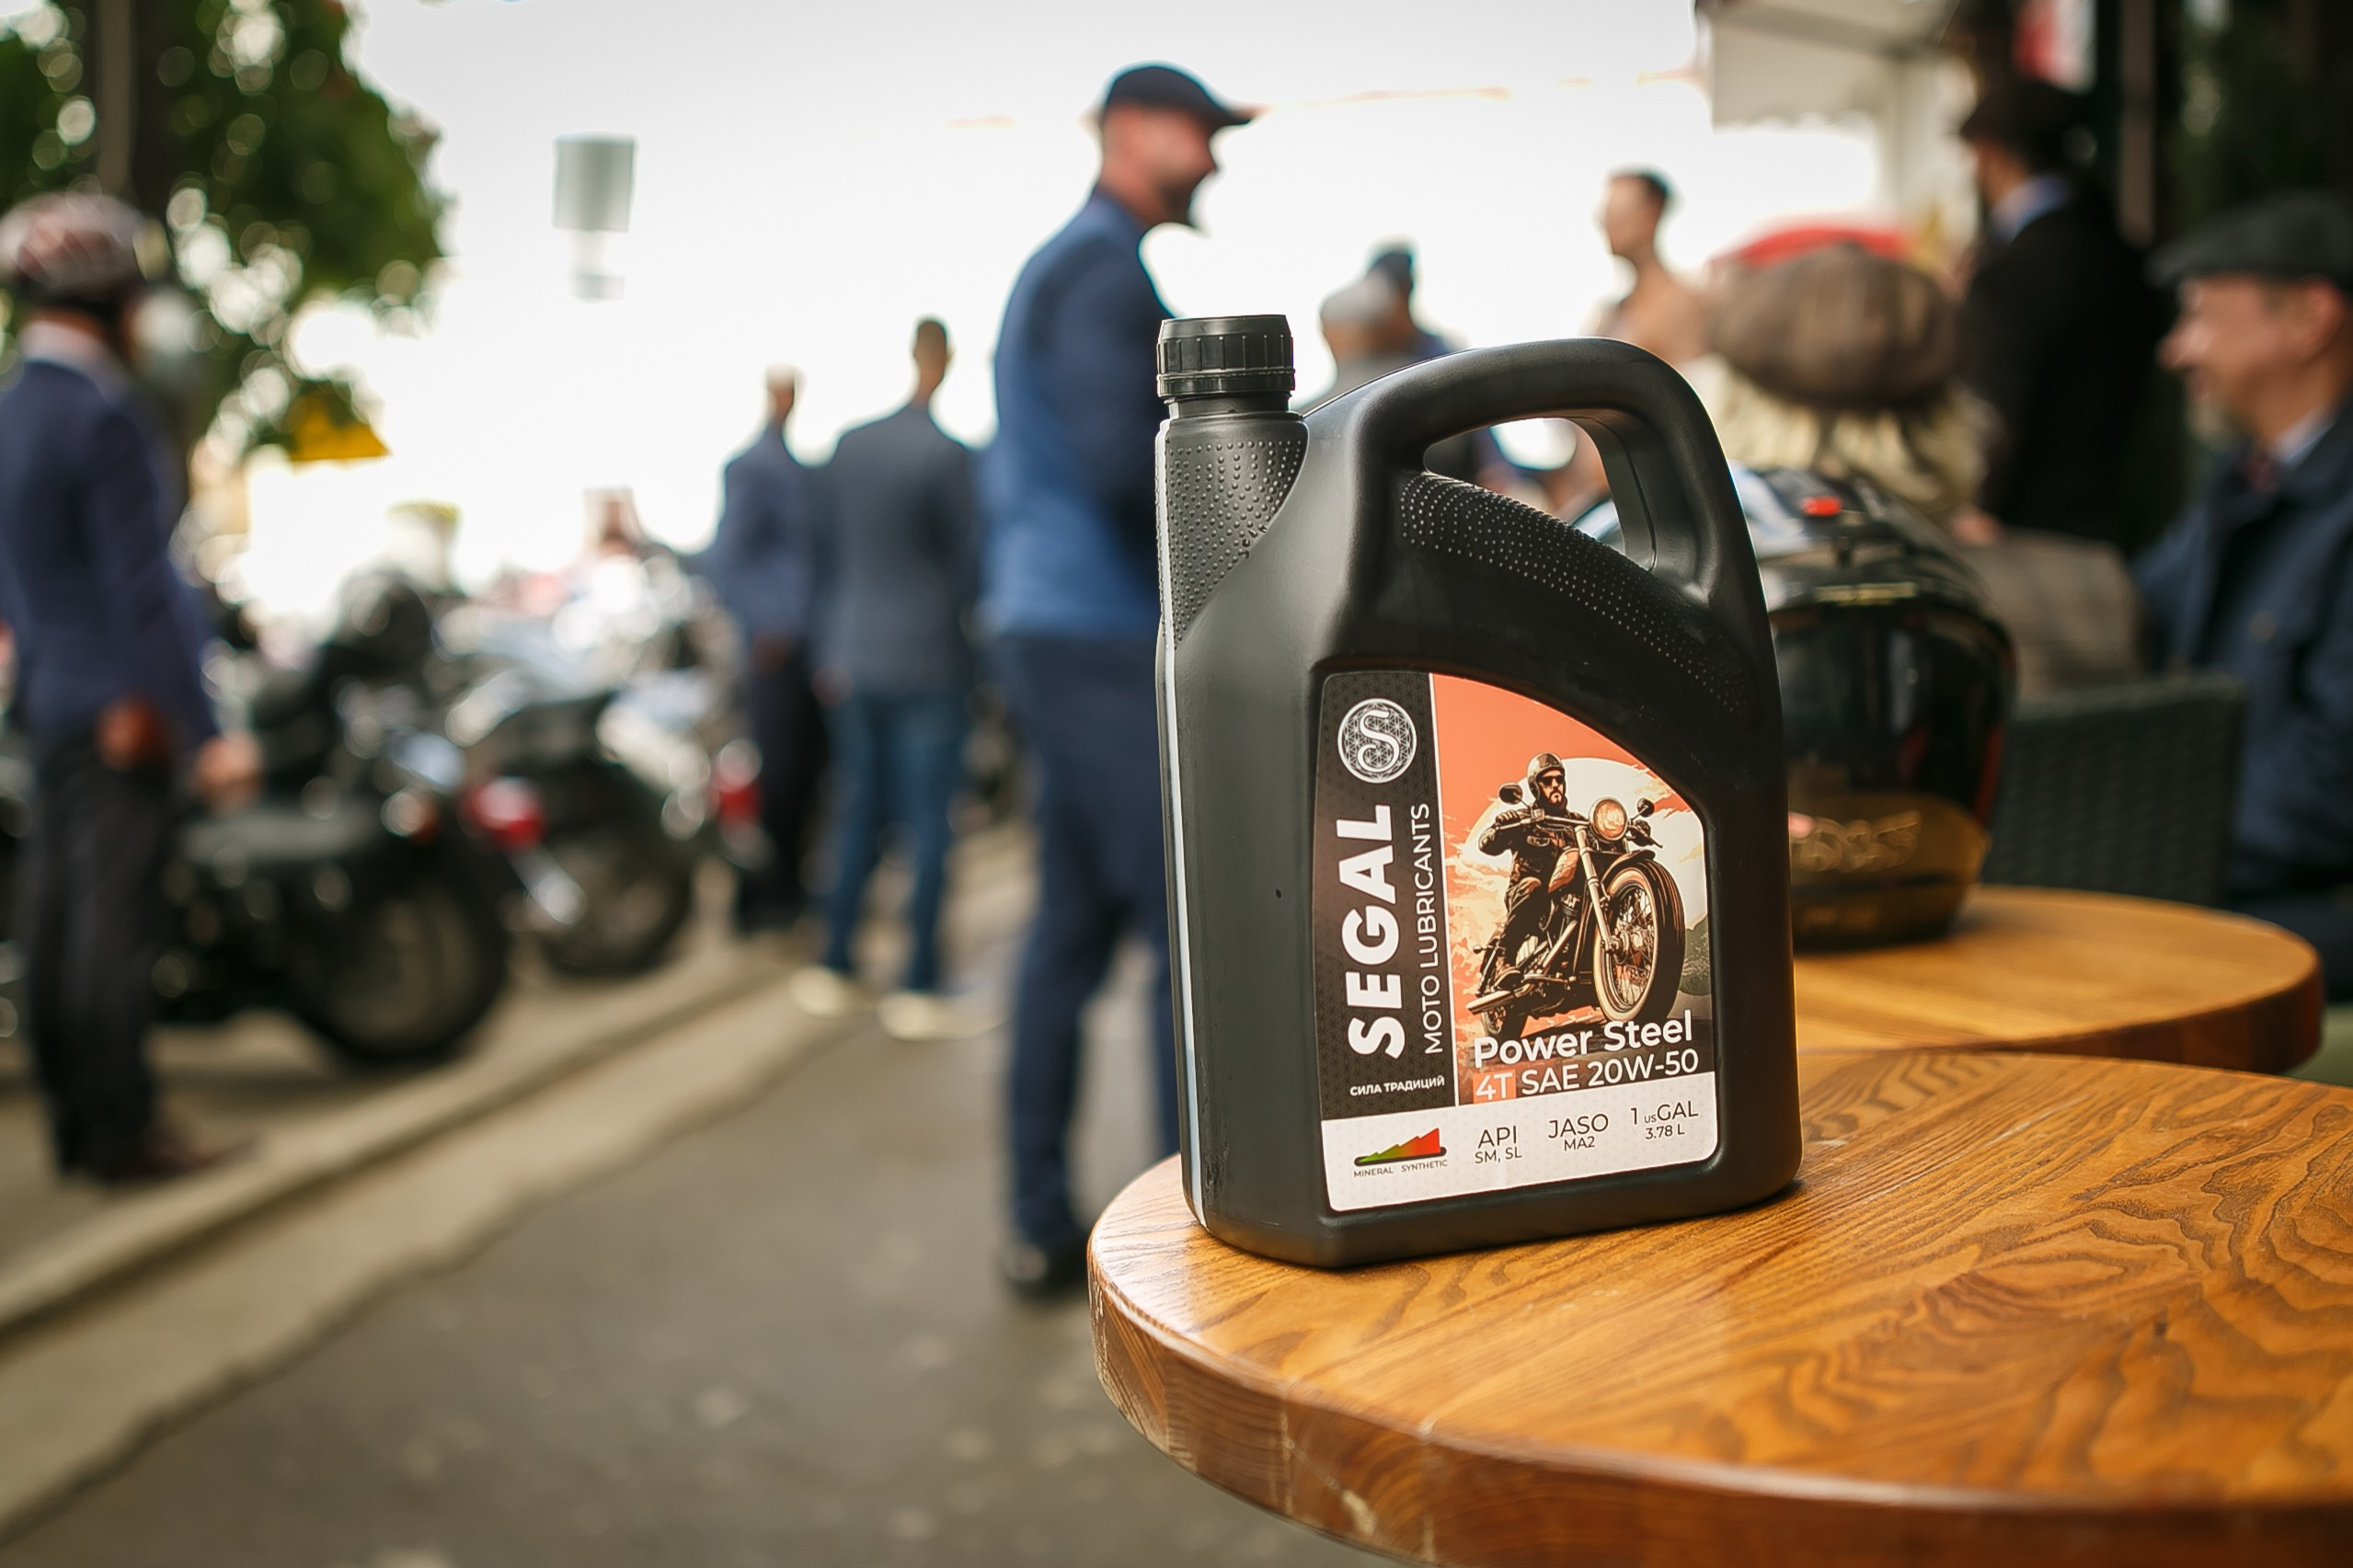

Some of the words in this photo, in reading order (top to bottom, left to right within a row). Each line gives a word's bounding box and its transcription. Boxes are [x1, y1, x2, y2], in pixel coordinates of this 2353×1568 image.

[1409, 802, 1440, 968] LUBRICANTS
[1336, 804, 1406, 1059] SEGAL
[1420, 973, 1444, 1055] MOTO
[1474, 1030, 1593, 1069] Power
[1603, 1009, 1693, 1052] Steel
[1349, 1083, 1383, 1097] СИЛА
[1383, 1075, 1445, 1093] ТРАДИЦИЙ
[1475, 1072, 1513, 1101] 4T
[1521, 1064, 1580, 1095] SAE
[1587, 1048, 1699, 1087] 20W-50
[1548, 1113, 1609, 1139] JASO
[1630, 1106, 1638, 1125] 1
[1477, 1125, 1518, 1149] API
[1645, 1124, 1673, 1139] 3.78
[1677, 1123, 1685, 1136] L
[1475, 1150, 1501, 1164] SM,
[1504, 1146, 1522, 1160] SL
[1563, 1136, 1596, 1151] MA2
[1353, 1166, 1394, 1178] MINERAL
[1401, 1159, 1448, 1173] SYNTHETIC
